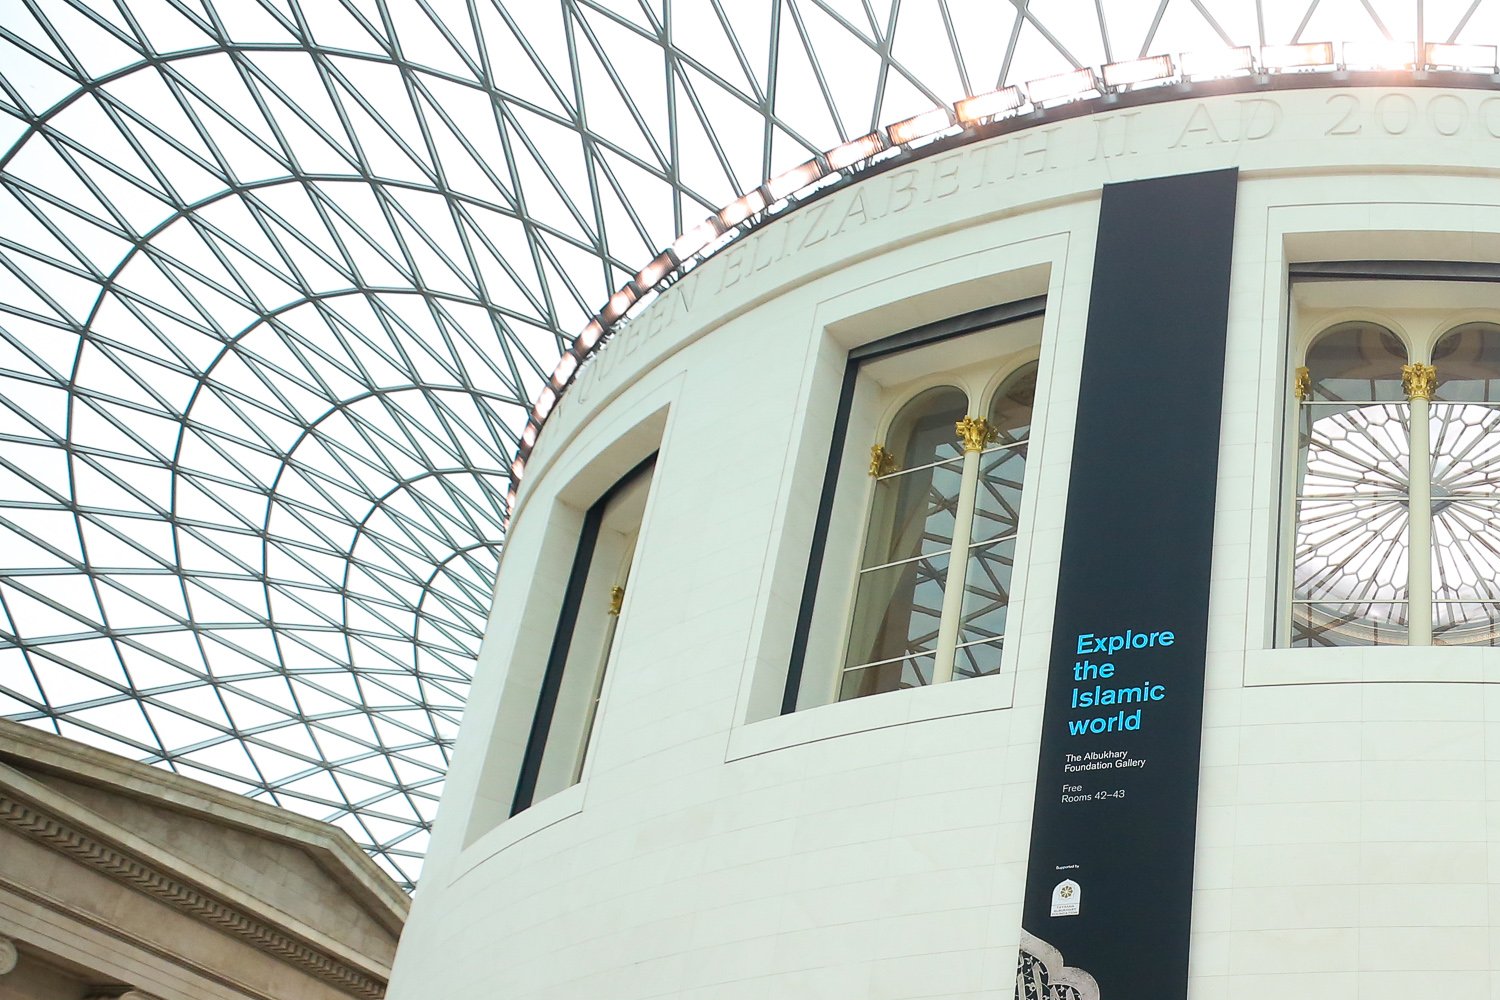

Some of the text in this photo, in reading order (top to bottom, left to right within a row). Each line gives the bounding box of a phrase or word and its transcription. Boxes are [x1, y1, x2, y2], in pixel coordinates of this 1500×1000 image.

[714, 126, 1062, 296] ELIZABETH
[1088, 111, 1142, 163] II
[1168, 98, 1284, 148] AD
[1077, 630, 1175, 655] Explore
[1073, 660, 1115, 681] the
[1071, 681, 1166, 708] Islamic
[1068, 709, 1142, 736] world
[1064, 758, 1147, 773] Foundation Gallery
[1065, 750, 1128, 763] The Albukhary
[1061, 794, 1092, 804] Rooms
[1062, 784, 1083, 793] Free
